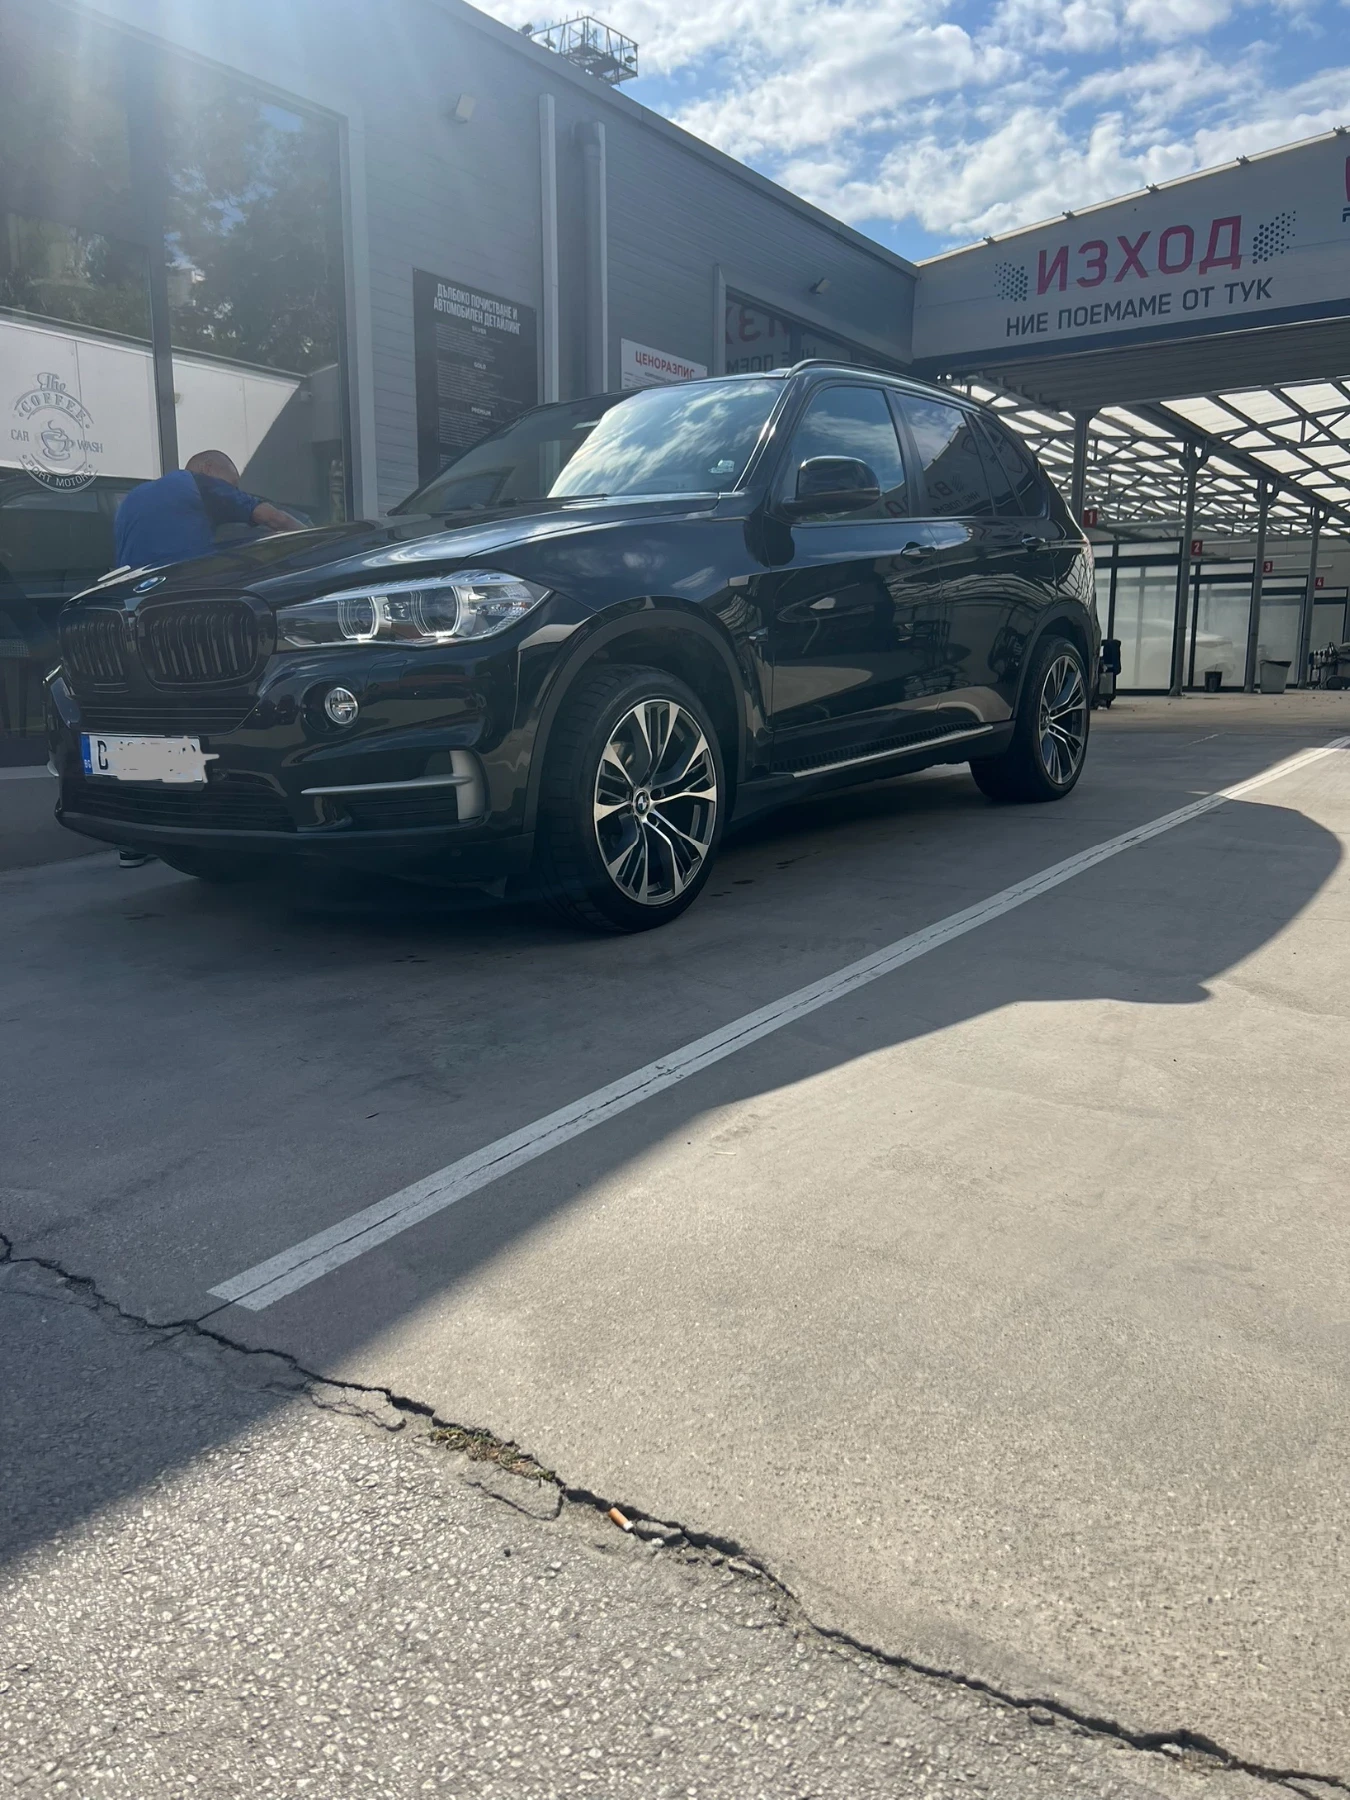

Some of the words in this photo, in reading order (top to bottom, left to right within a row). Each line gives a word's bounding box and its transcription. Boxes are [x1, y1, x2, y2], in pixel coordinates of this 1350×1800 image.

[1037, 215, 1243, 295] ИЗХОД
[436, 283, 470, 306] ДЪЛБОКО
[471, 294, 512, 320] ПОЧИСТВАНЕ
[512, 308, 518, 321] И
[1006, 312, 1049, 337] НИЕ
[1058, 292, 1172, 329] ПОЕМАМЕ
[1182, 286, 1215, 311] ОТ
[1224, 276, 1274, 304] ТУК
[433, 296, 484, 324] АВТОМОБИЛЕН
[484, 312, 521, 336] ДЕТАЙЛИНГ
[37, 372, 67, 393] The
[21, 392, 87, 422] COFFEE
[10, 429, 30, 442] CAR
[76, 440, 104, 453] WASH
[26, 461, 52, 483] PORT
[55, 468, 93, 487] MOTORS
[1088, 512, 1094, 524] 1
[1193, 542, 1200, 553] 2
[1265, 562, 1271, 572] 3
